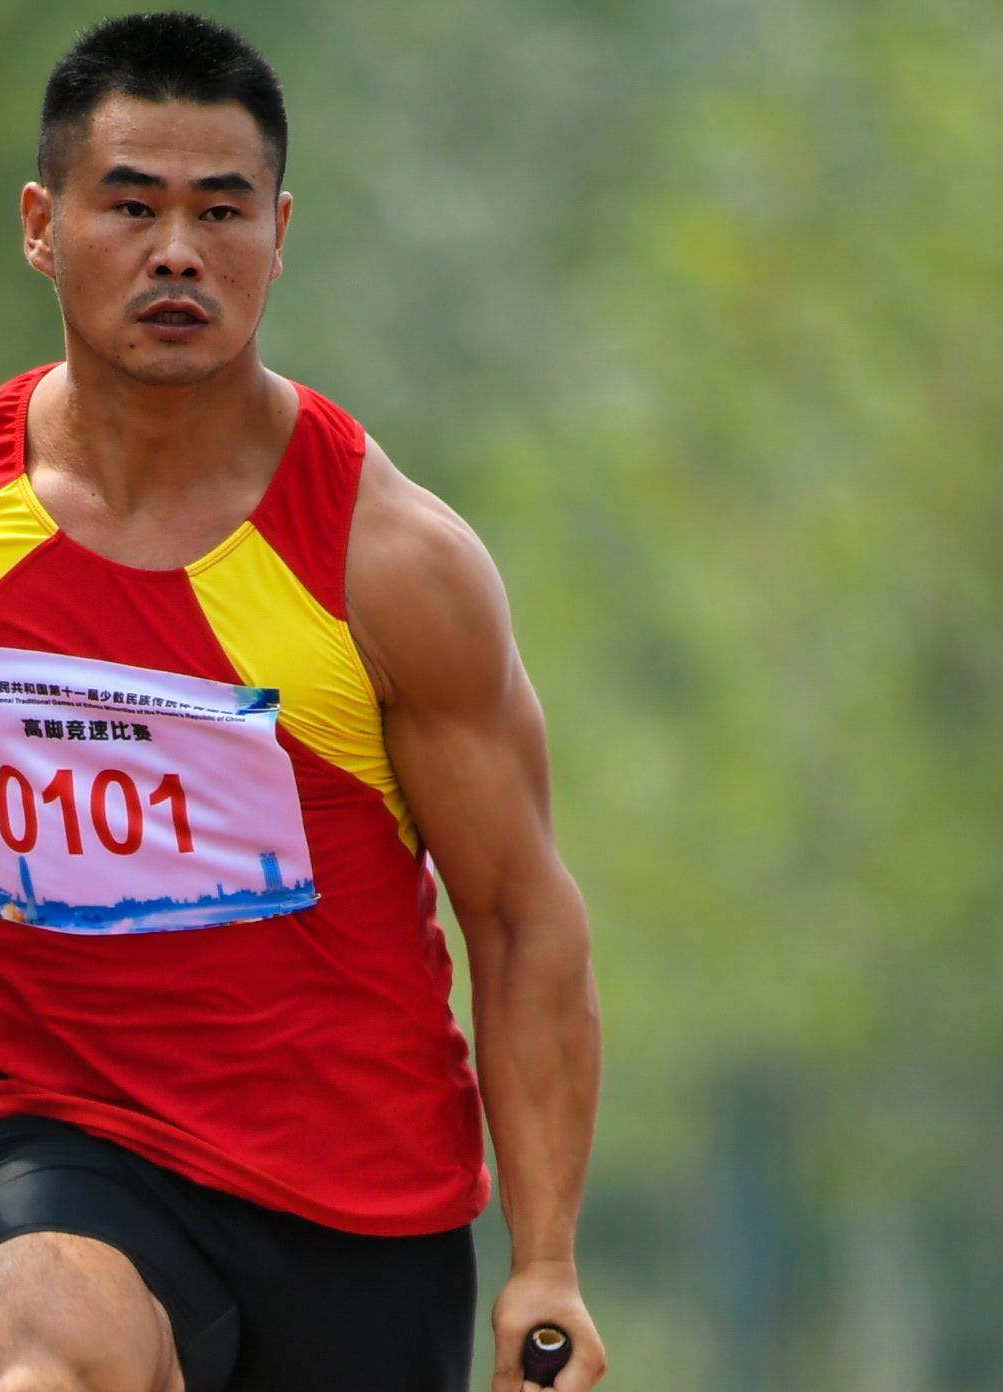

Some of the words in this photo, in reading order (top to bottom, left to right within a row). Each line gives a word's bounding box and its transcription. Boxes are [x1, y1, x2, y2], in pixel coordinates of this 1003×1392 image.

[15, 697, 51, 705] Traditional
[83, 702, 103, 710] Ethnic
[104, 705, 135, 714] Minorities
[156, 710, 184, 718] People's
[185, 713, 215, 722] Republic
[22, 719, 152, 741] 高脚竞速比赛
